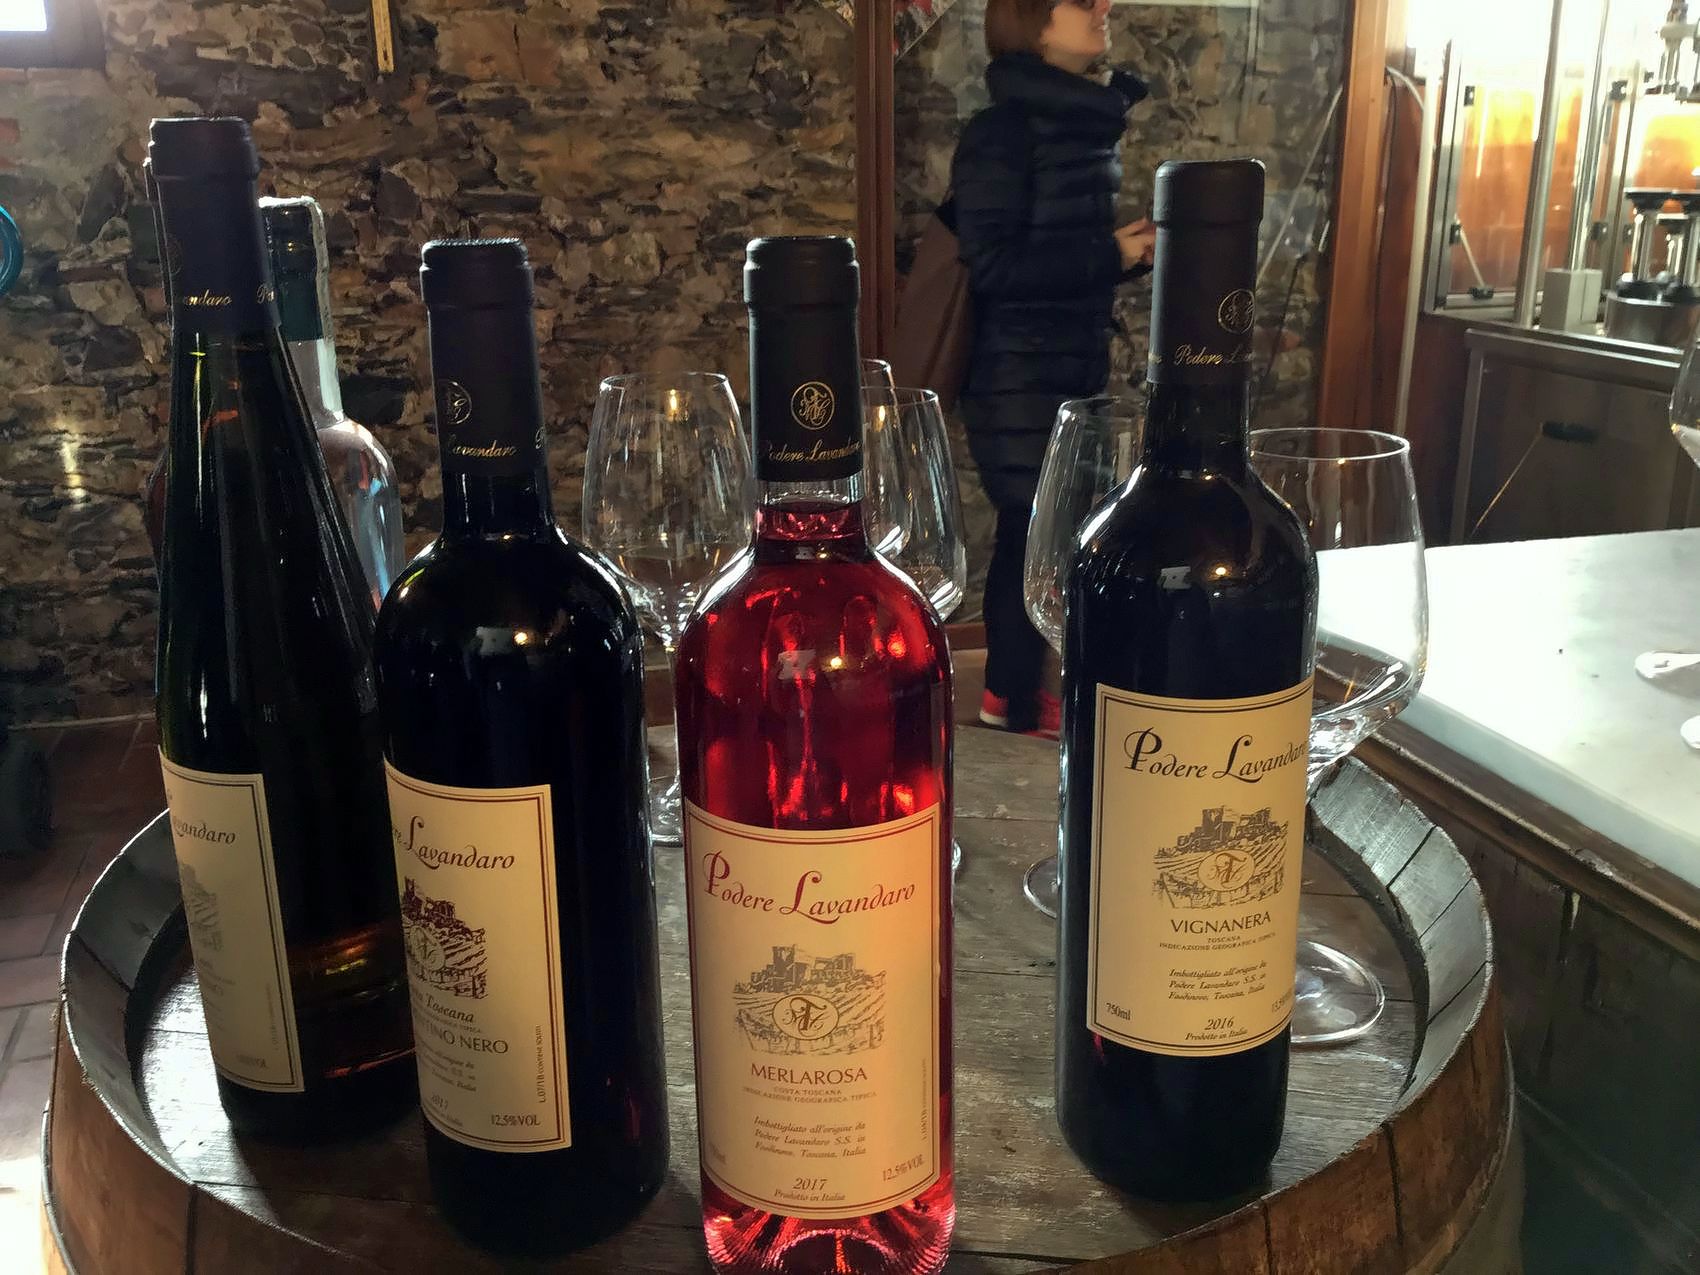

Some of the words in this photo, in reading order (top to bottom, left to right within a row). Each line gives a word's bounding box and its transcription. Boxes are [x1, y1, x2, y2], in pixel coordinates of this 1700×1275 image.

[1123, 727, 1208, 779] Podere
[403, 815, 516, 871] Lavandaro
[703, 850, 775, 912] Podere
[779, 870, 916, 925] Lavandaro
[1170, 911, 1271, 934] VIGNANERA
[1204, 1017, 1235, 1031] 2016
[460, 1035, 509, 1054] NERO
[751, 1062, 868, 1085] MERLAROSA
[792, 1177, 828, 1191] 2017
